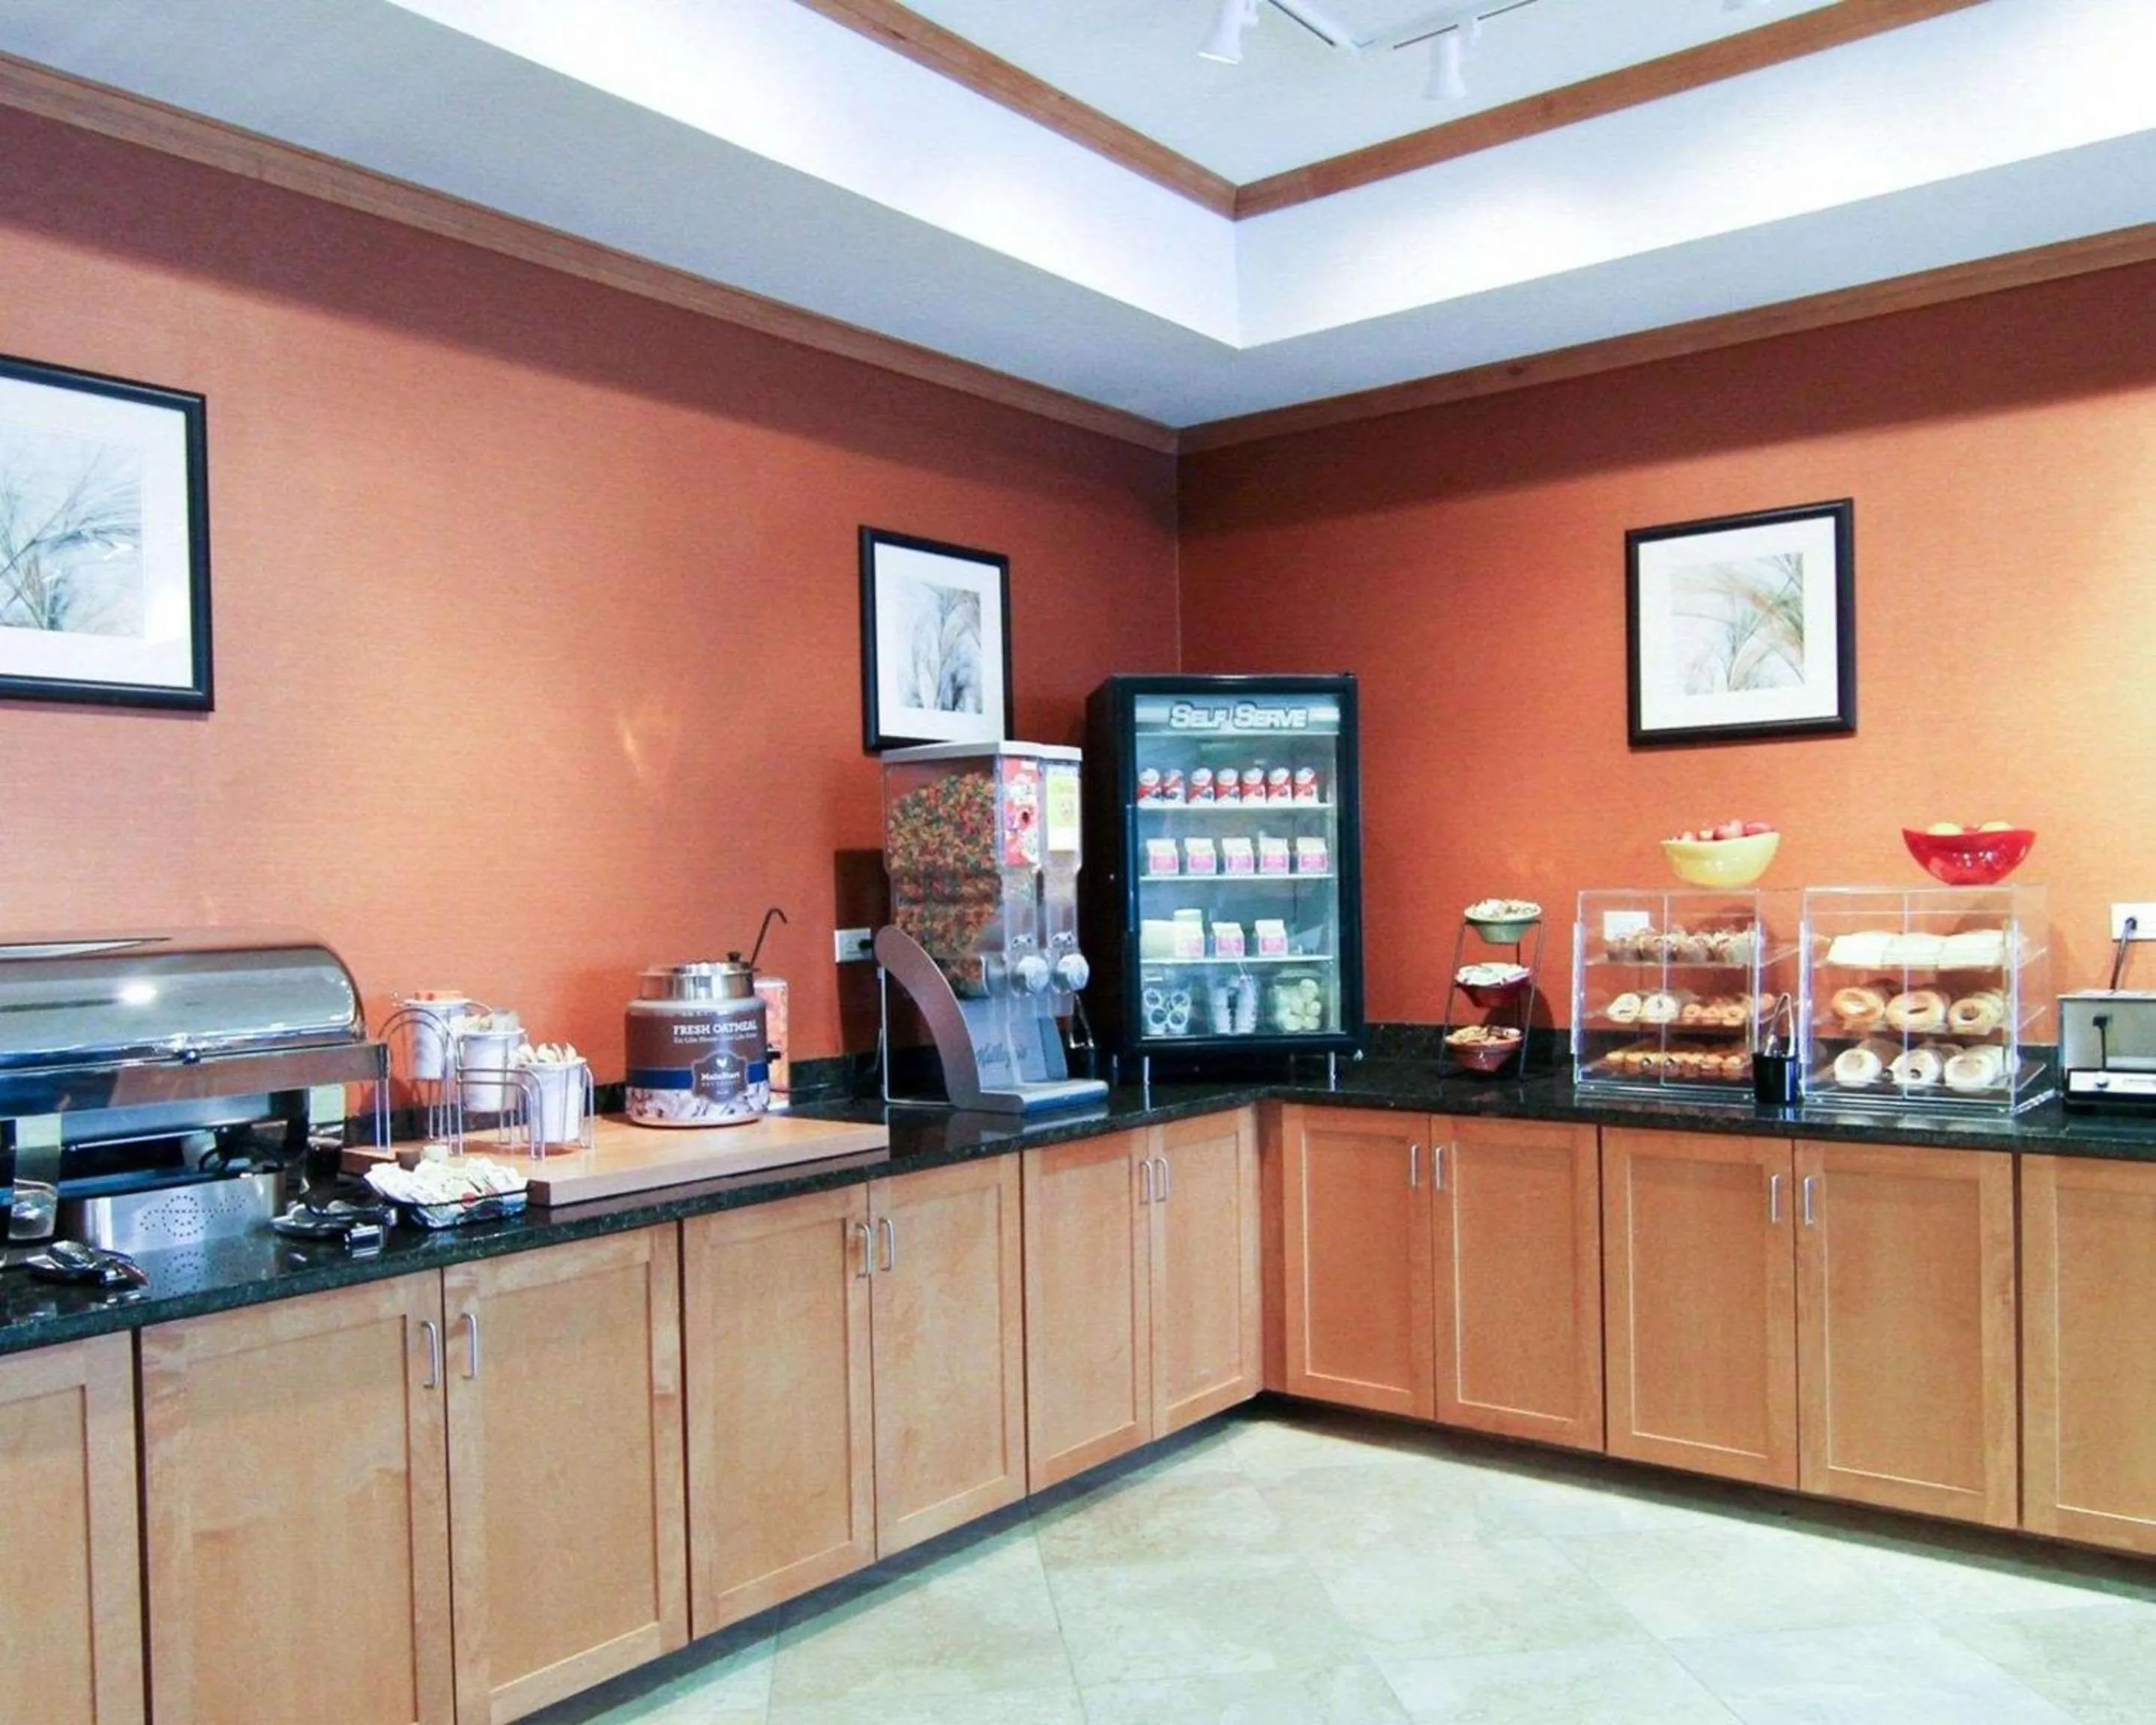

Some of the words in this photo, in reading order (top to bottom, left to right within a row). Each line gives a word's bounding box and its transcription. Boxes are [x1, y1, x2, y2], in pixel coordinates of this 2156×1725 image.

[1234, 702, 1308, 729] SERVE
[673, 1024, 710, 1035] FRESH
[713, 1020, 757, 1033] OATMEAL
